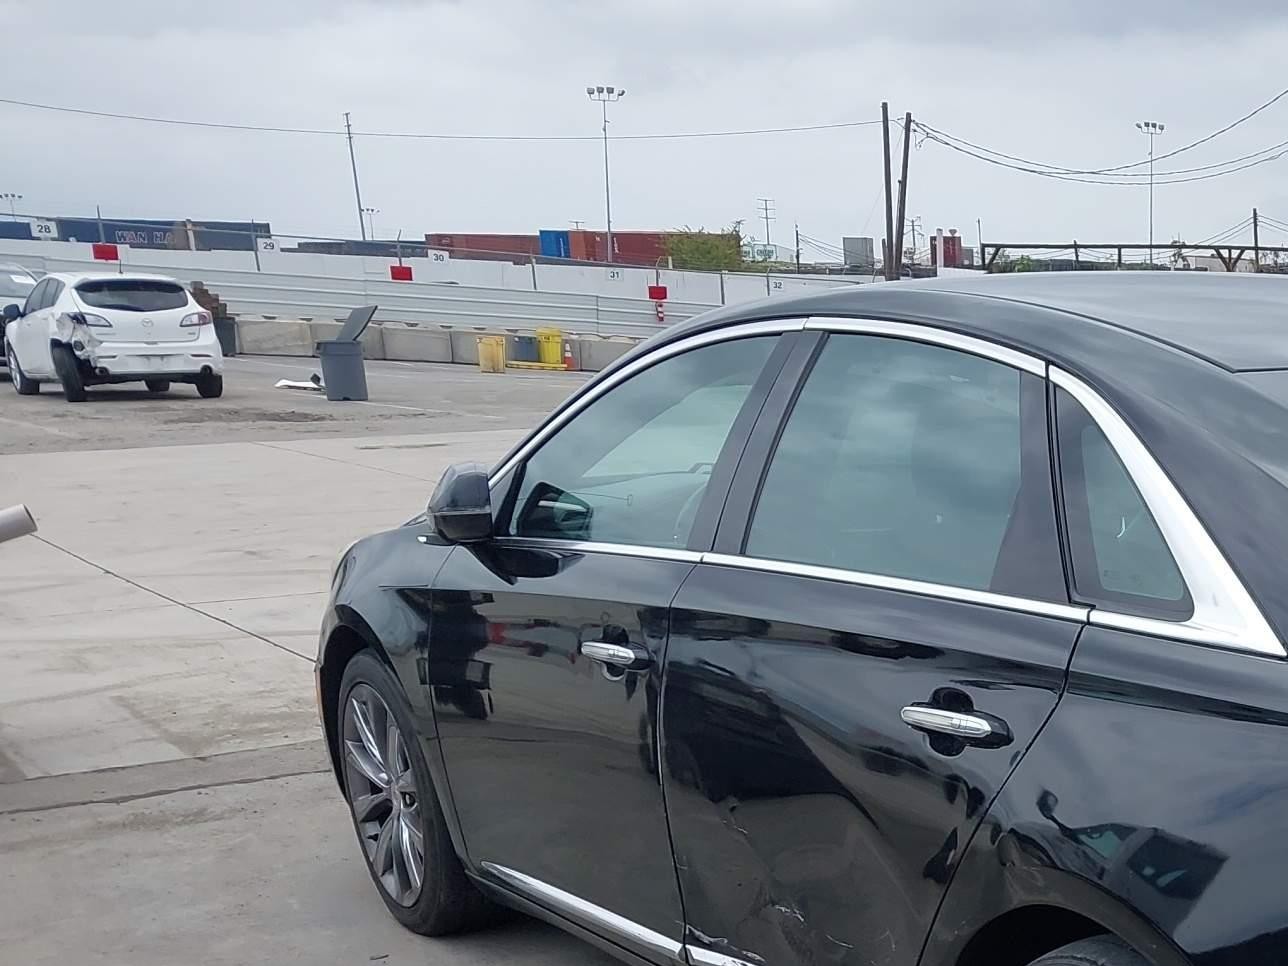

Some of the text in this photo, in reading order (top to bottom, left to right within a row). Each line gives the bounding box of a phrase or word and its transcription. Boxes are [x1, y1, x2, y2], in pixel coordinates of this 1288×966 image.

[36, 224, 51, 234] 28
[114, 230, 148, 244] WAN
[262, 241, 275, 251] 29
[433, 253, 445, 262] 30
[610, 271, 620, 279] 31
[773, 281, 782, 289] 32
